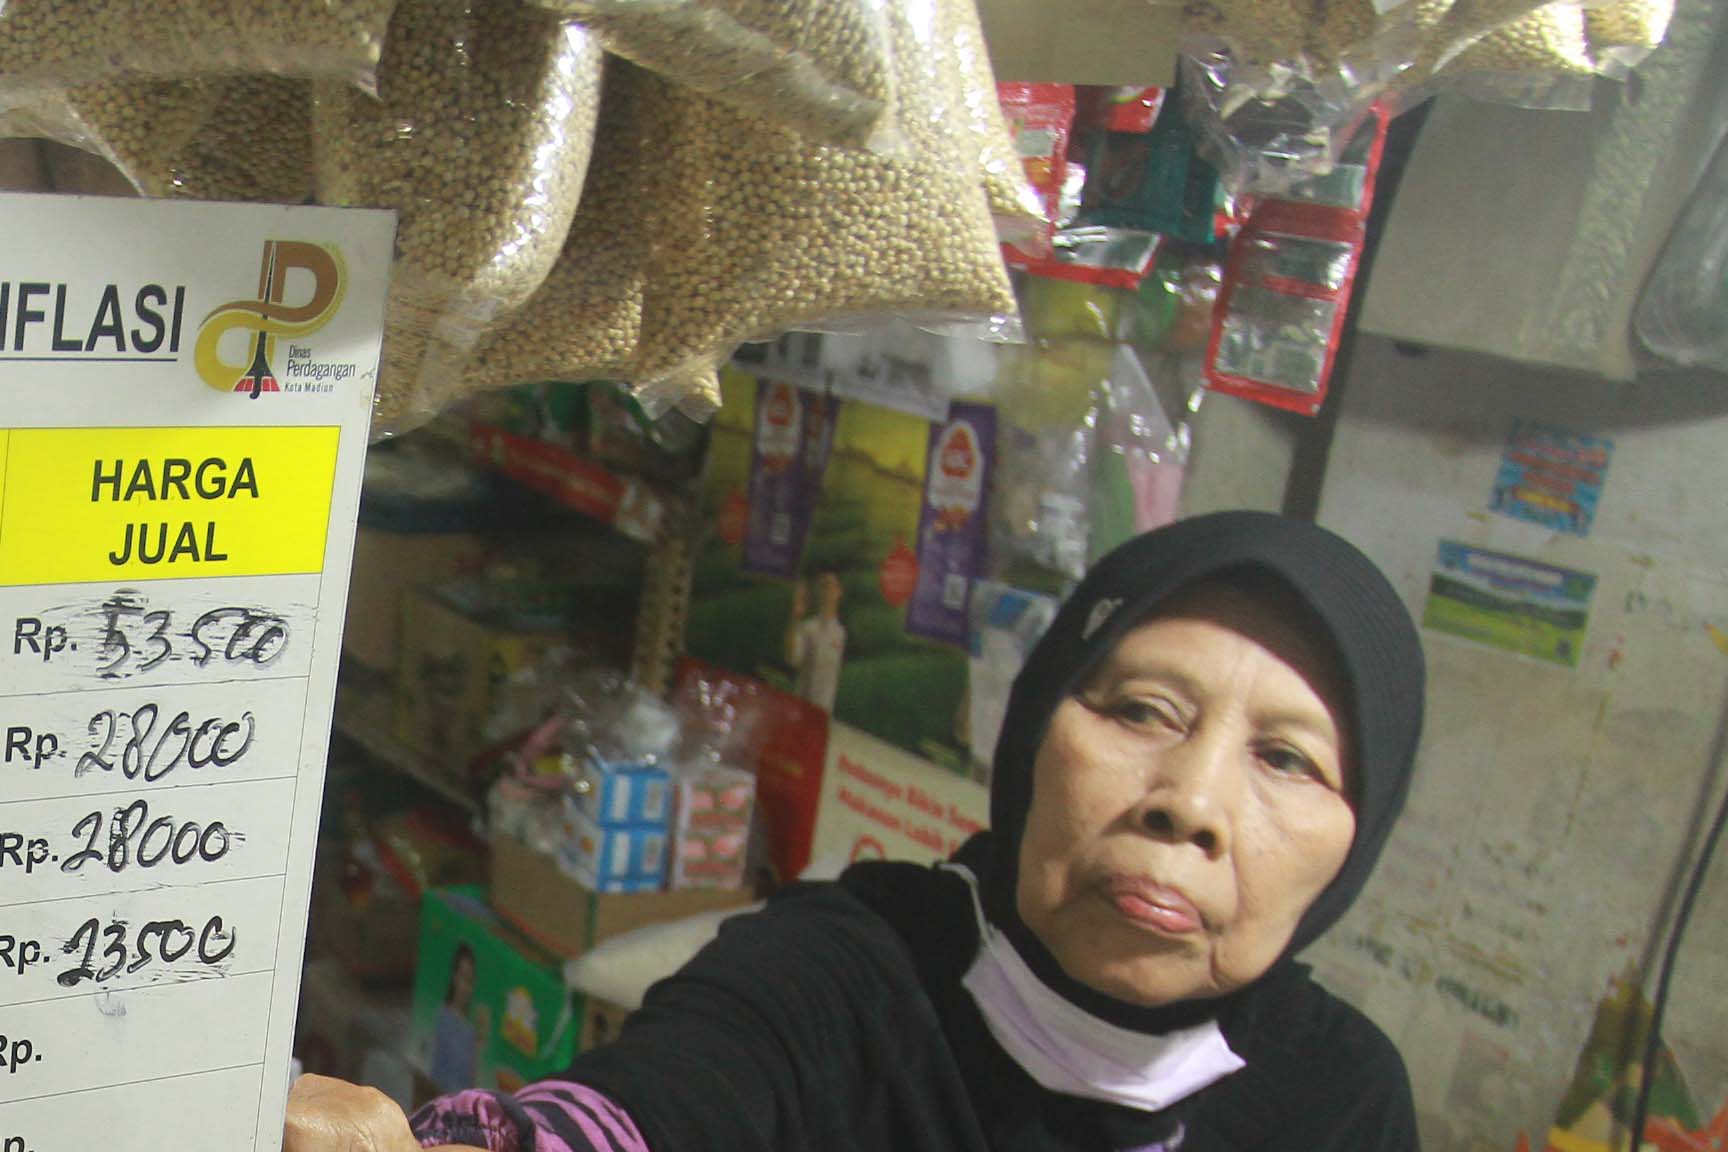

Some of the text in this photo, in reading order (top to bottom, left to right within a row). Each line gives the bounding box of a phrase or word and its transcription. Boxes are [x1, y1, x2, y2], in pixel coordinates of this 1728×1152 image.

[288, 344, 312, 359] Dinas
[286, 358, 357, 381] Perdagangan
[284, 382, 303, 393] Kota
[91, 457, 259, 502] HARGA
[108, 521, 228, 566] JUAL
